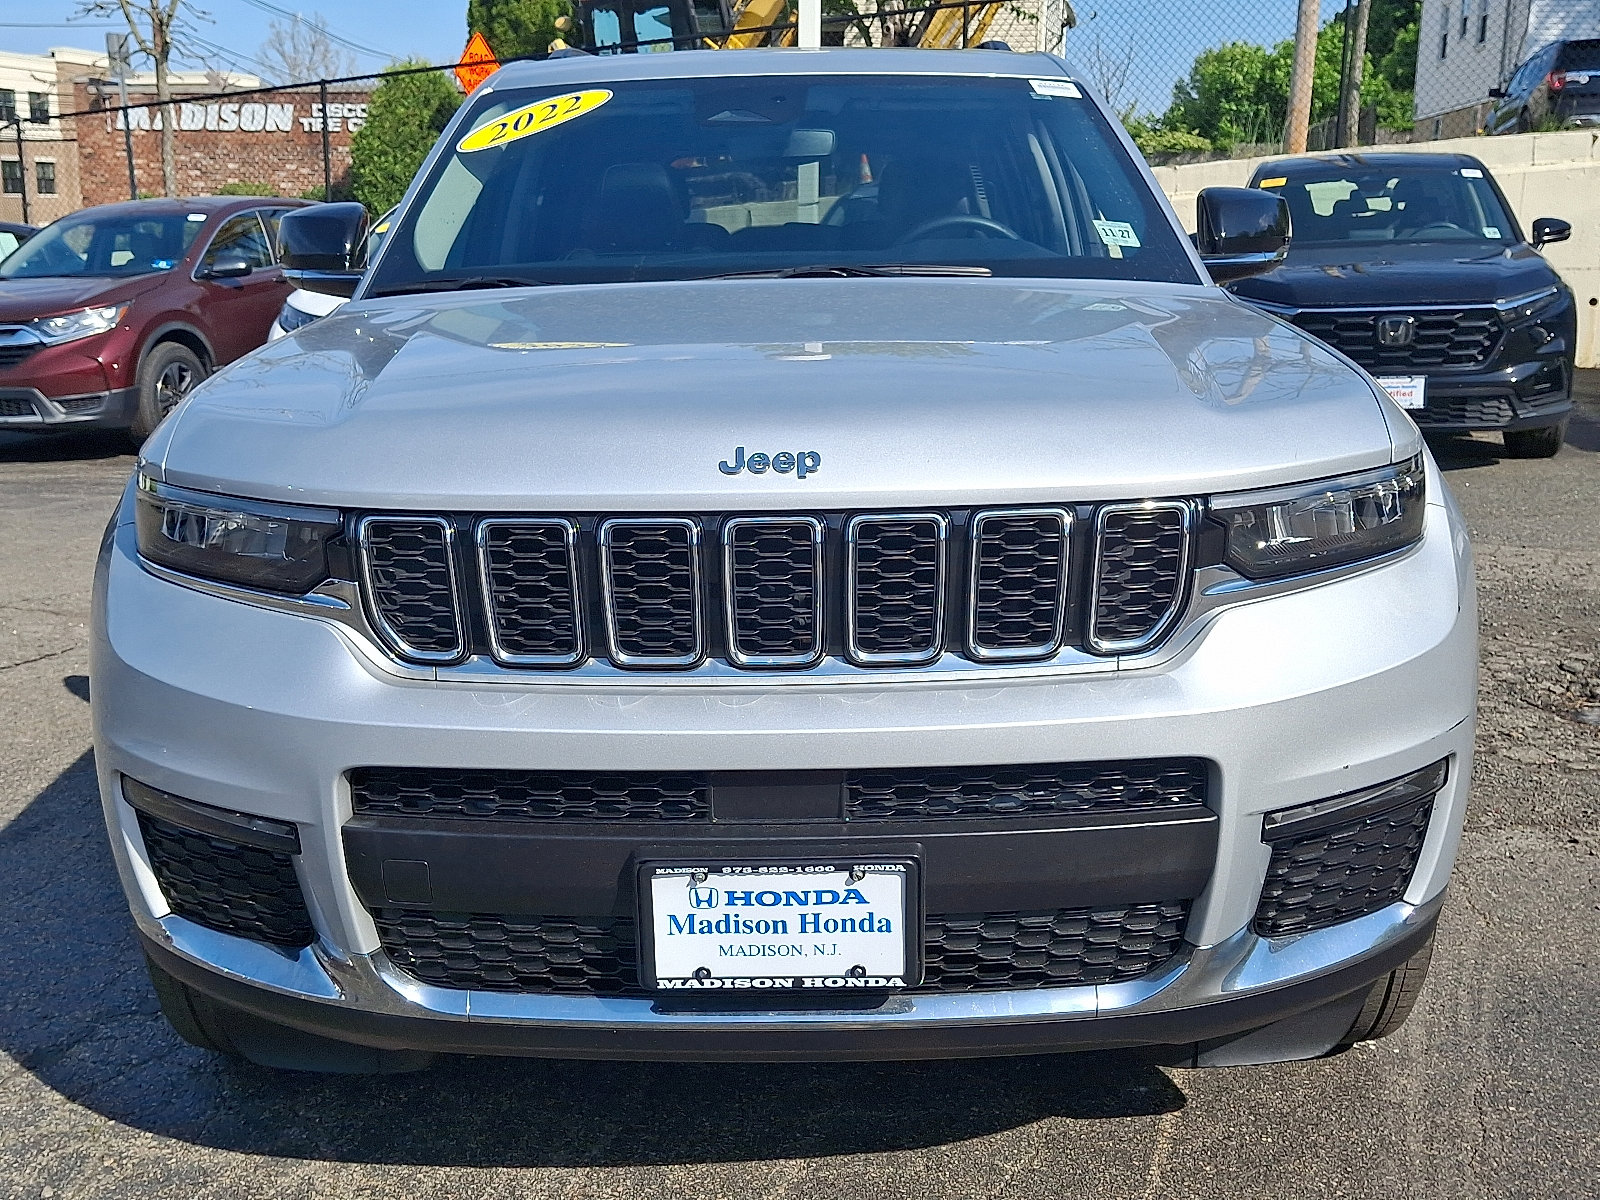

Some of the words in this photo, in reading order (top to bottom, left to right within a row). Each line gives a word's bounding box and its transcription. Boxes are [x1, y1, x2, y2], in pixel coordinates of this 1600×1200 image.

[115, 103, 294, 132] MADISON
[488, 96, 582, 144] 2022
[1101, 227, 1117, 237] 11
[1118, 229, 1131, 239] 27
[718, 446, 821, 479] Jeep
[655, 867, 709, 875] MADISON
[852, 864, 907, 872] HONDA
[723, 888, 870, 907] HONDA
[667, 913, 788, 936] Madison
[798, 911, 892, 935] Honda
[719, 944, 808, 959] MADISON,
[813, 943, 842, 957] N.J.
[656, 977, 794, 990] MADISON
[801, 977, 907, 989] HONDA
